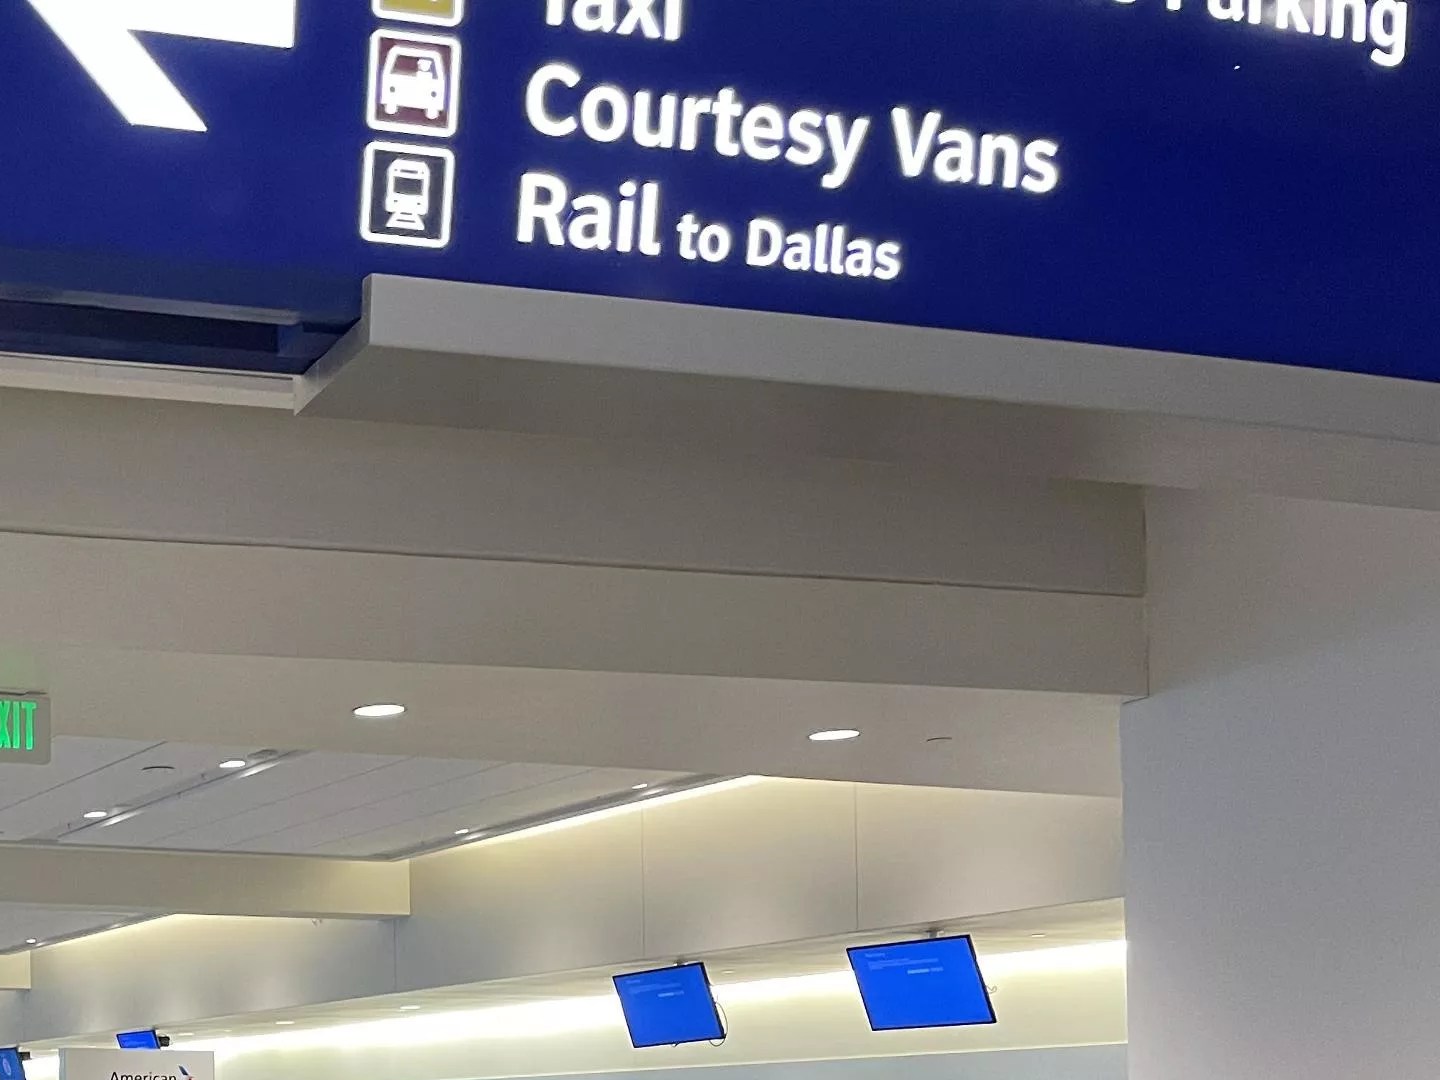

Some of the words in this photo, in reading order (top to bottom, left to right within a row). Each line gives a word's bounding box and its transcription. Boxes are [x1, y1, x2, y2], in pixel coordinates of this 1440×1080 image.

[525, 63, 869, 188] Courtesy
[891, 107, 1060, 193] Vans
[516, 173, 661, 256] Rail
[677, 213, 731, 262] to
[747, 218, 902, 280] Dallas
